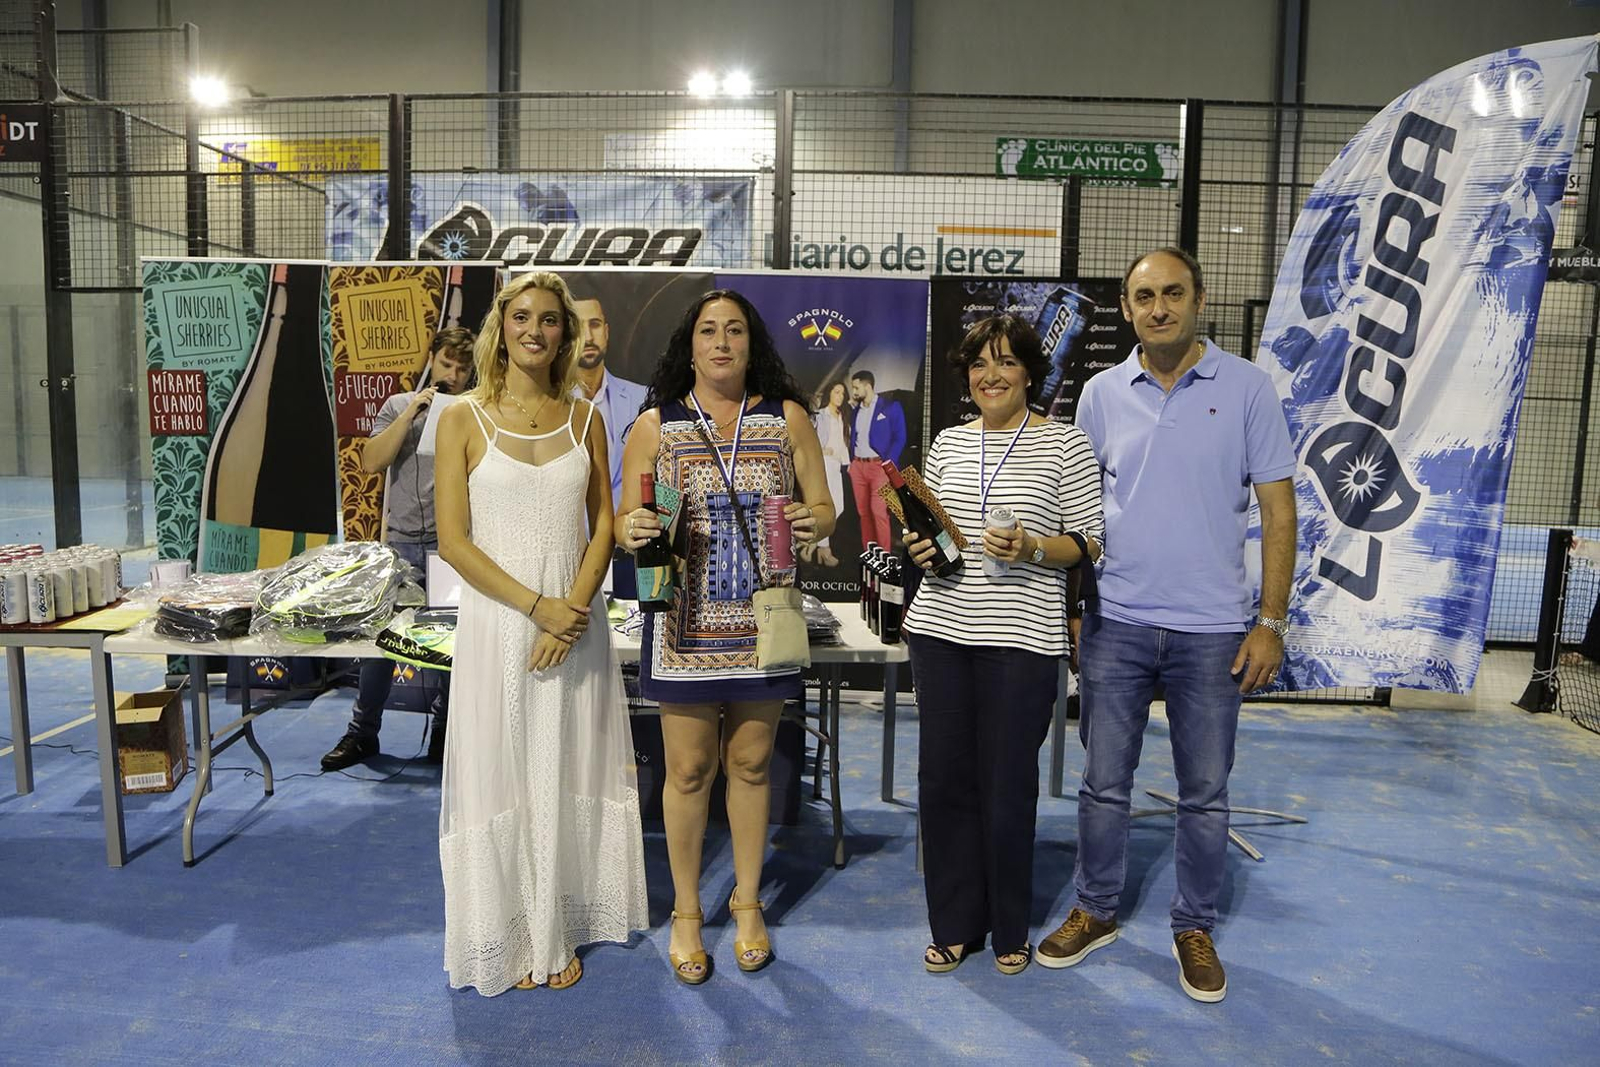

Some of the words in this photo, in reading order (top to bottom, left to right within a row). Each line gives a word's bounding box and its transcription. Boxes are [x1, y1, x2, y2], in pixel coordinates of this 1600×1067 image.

[1094, 143, 1117, 153] DEL
[1123, 142, 1147, 155] PIE
[880, 232, 926, 272] de
[935, 236, 1025, 276] Jerez
[175, 296, 231, 319] UNUSUAL
[359, 298, 410, 322] UNUSUAL
[788, 308, 854, 328] SPAGNOLO
[177, 323, 232, 348] SHERRIES
[361, 325, 411, 350] SHERRIES
[198, 356, 236, 367] ROMATE
[379, 358, 415, 368] ROMATE
[152, 371, 202, 393] MÍRAME
[338, 374, 393, 404] ¿FUEGO?
[153, 395, 203, 413] CUANDO
[364, 402, 377, 416] NO
[154, 416, 167, 430] TE
[171, 415, 203, 430] HABLO
